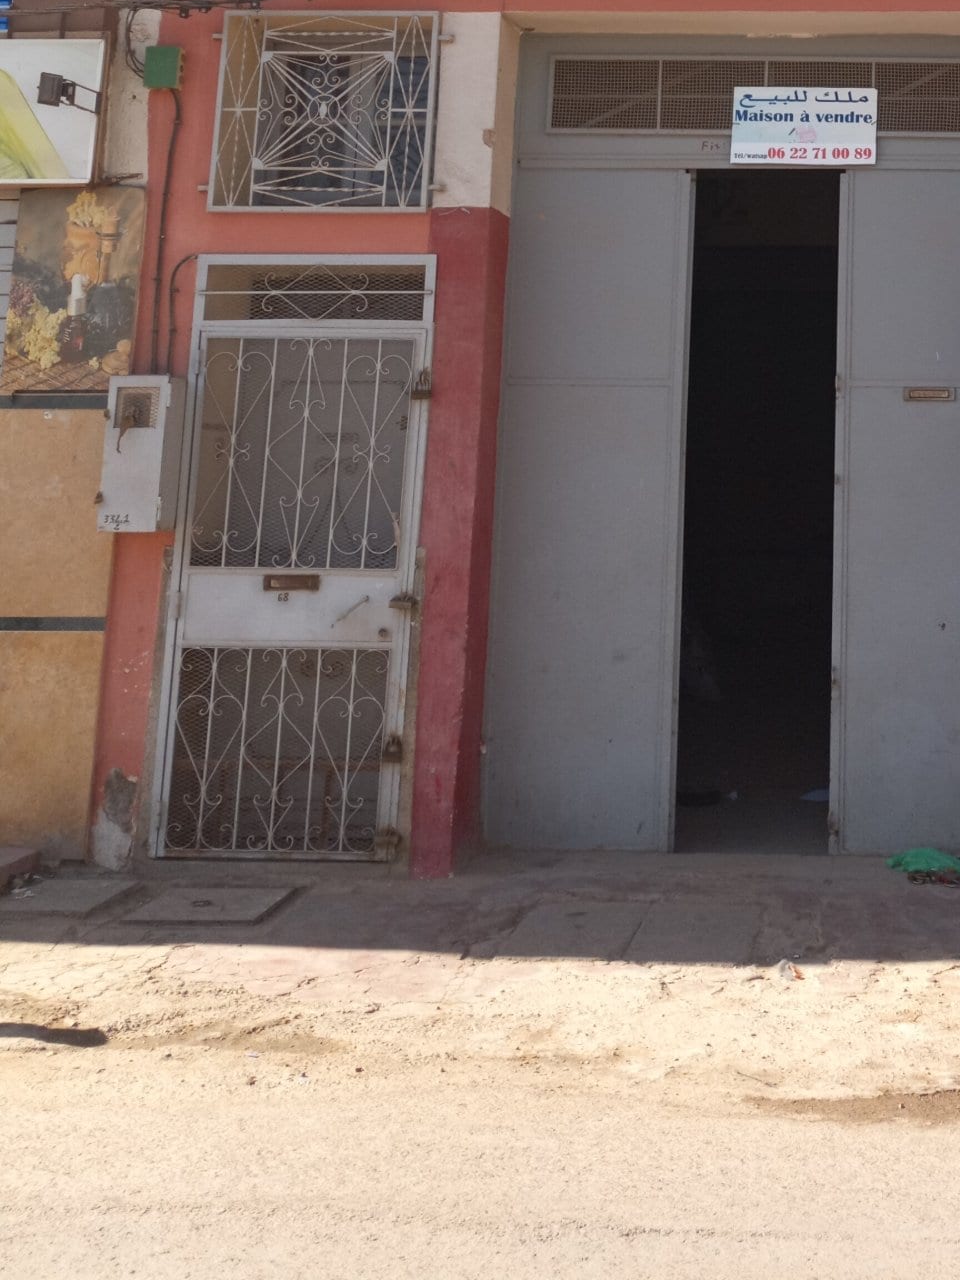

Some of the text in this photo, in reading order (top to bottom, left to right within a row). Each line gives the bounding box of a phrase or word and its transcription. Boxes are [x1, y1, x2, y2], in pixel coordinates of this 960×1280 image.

[739, 90, 869, 108] ملك للبيع
[734, 109, 872, 124] Maison à vendre
[767, 147, 785, 159] 06
[789, 147, 808, 159] 22
[812, 147, 828, 159] 71
[832, 147, 850, 159] 00
[854, 147, 872, 160] 89
